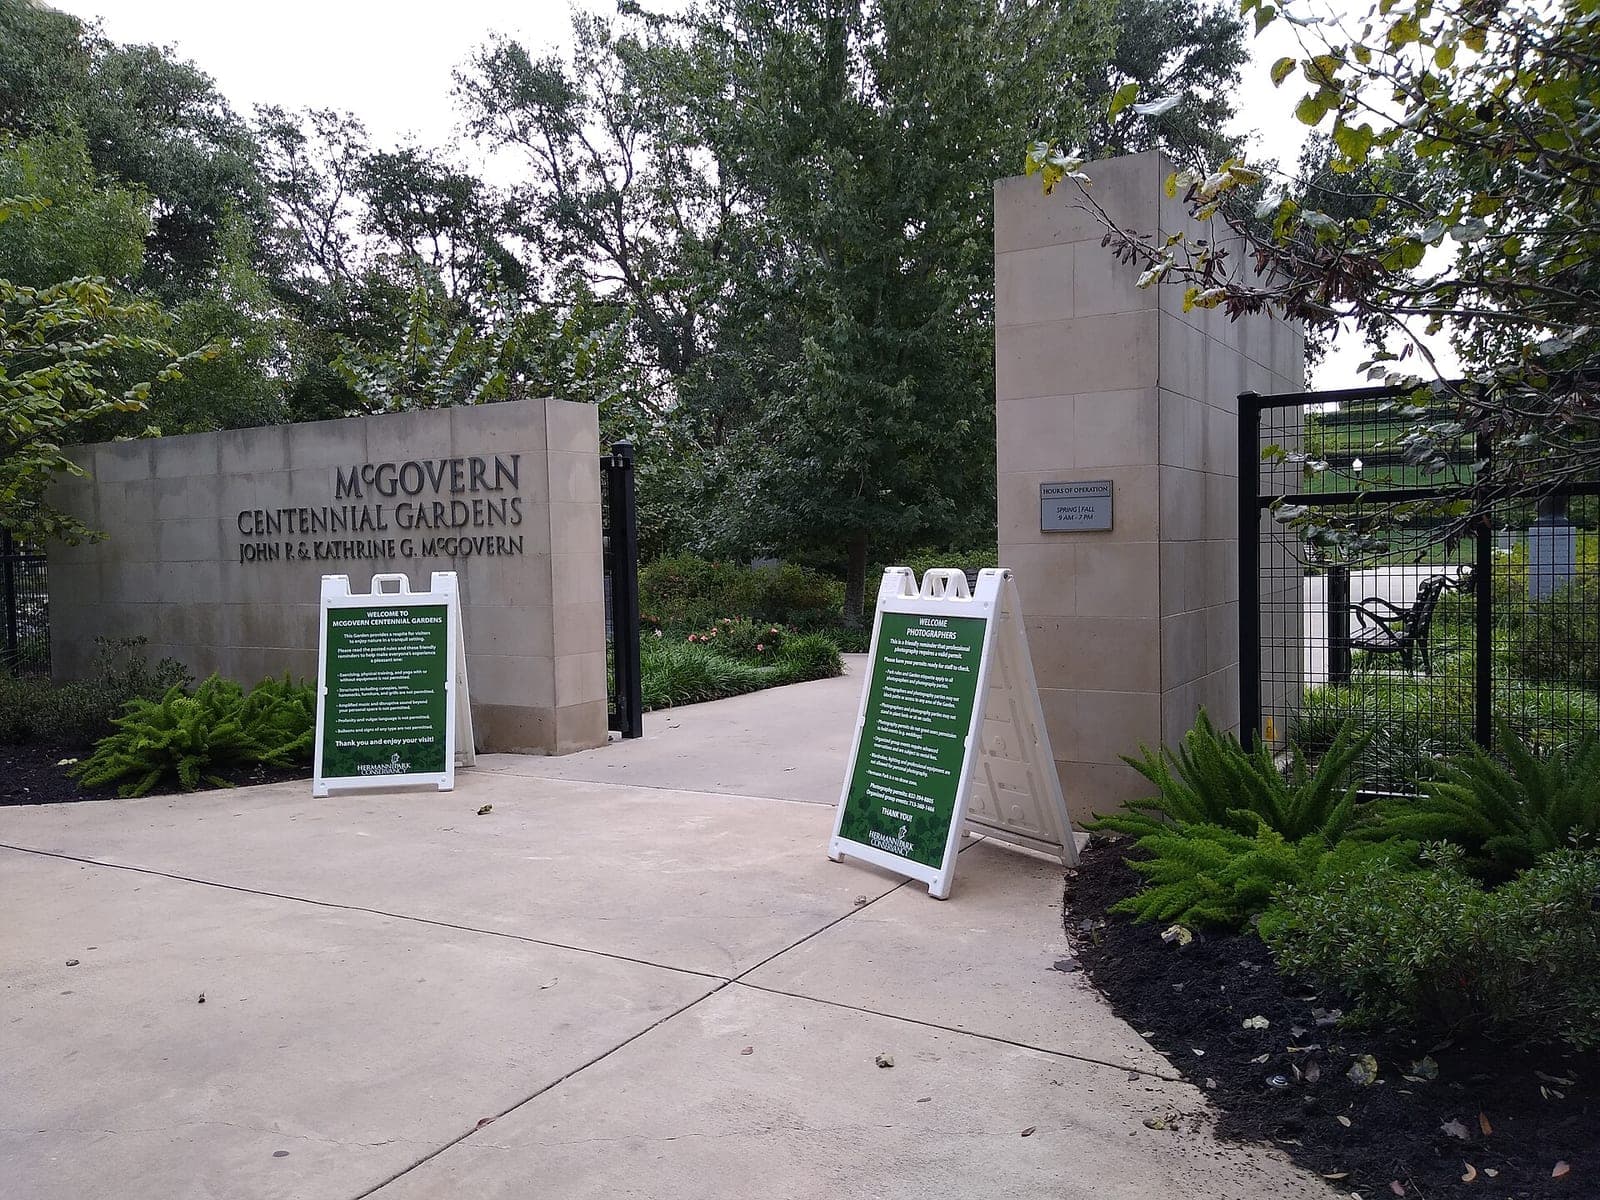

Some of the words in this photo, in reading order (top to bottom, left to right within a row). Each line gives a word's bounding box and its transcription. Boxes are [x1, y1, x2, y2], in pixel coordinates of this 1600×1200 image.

[1043, 487, 1063, 495] HOURS
[1073, 486, 1108, 494] OPERATION
[237, 504, 388, 536] CENTENNIAL
[395, 497, 523, 530] GARDENS
[240, 542, 280, 564] JOHN
[285, 542, 296, 560] P.
[298, 542, 310, 560] &
[313, 539, 396, 560] KATHRINE
[401, 538, 418, 558] G.
[920, 618, 947, 627] WELCOME
[907, 628, 956, 639] PHOTOGRAPHERS
[882, 807, 899, 818] THANK
[900, 812, 912, 822] YOU!
[869, 831, 896, 845] HERMANN
[899, 839, 913, 851] PARK
[871, 839, 909, 856] CONSERVANCY
